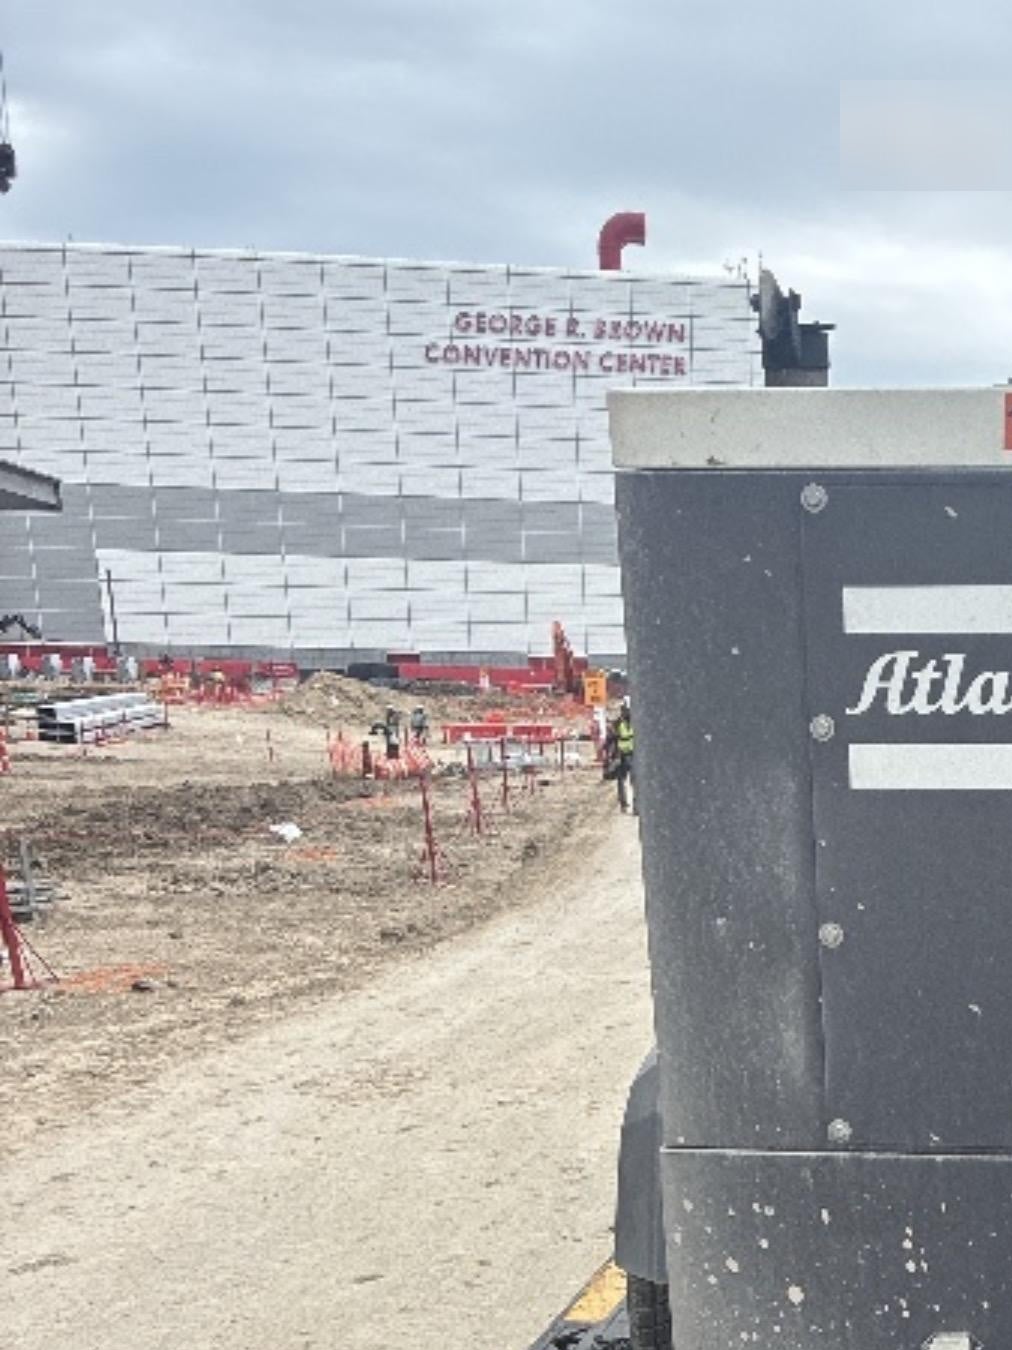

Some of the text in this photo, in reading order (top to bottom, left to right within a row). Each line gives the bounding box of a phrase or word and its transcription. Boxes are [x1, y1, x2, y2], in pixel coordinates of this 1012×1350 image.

[454, 311, 686, 344] GEORGE R. BROWN
[424, 342, 688, 376] CONVENTION CENTER
